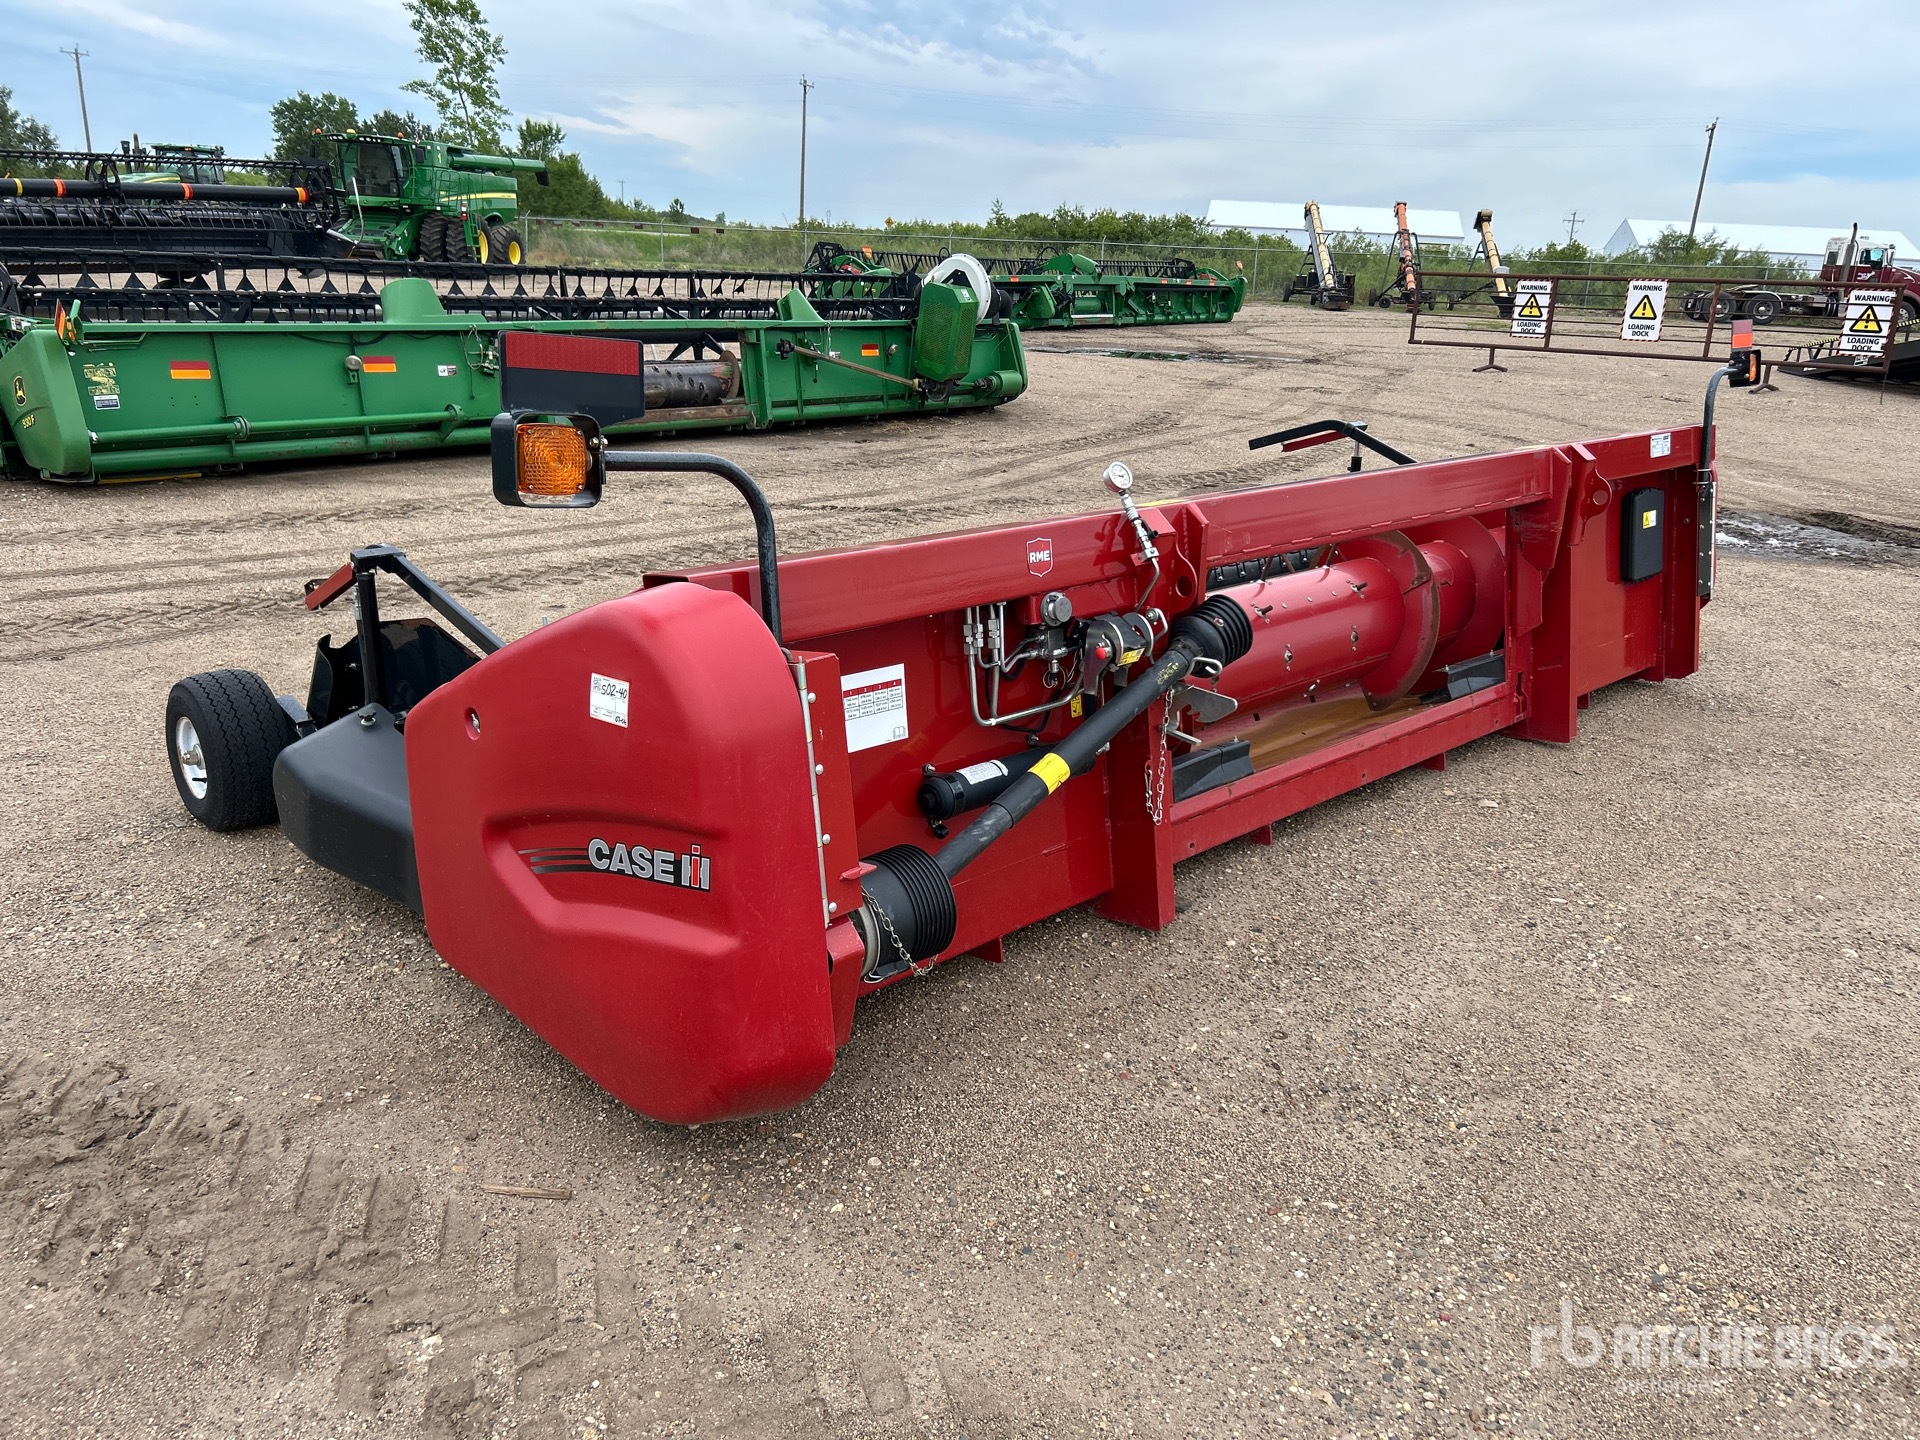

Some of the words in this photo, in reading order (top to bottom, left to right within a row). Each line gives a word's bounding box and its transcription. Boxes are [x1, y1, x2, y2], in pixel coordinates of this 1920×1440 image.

[1632, 284, 1663, 292] WARNING
[1854, 294, 1891, 302] WARNING
[1627, 323, 1656, 331] LOADING
[1846, 337, 1880, 345] LOADING
[1851, 344, 1873, 352] DOCK
[1029, 550, 1051, 564] RME
[588, 837, 675, 884] CASE
